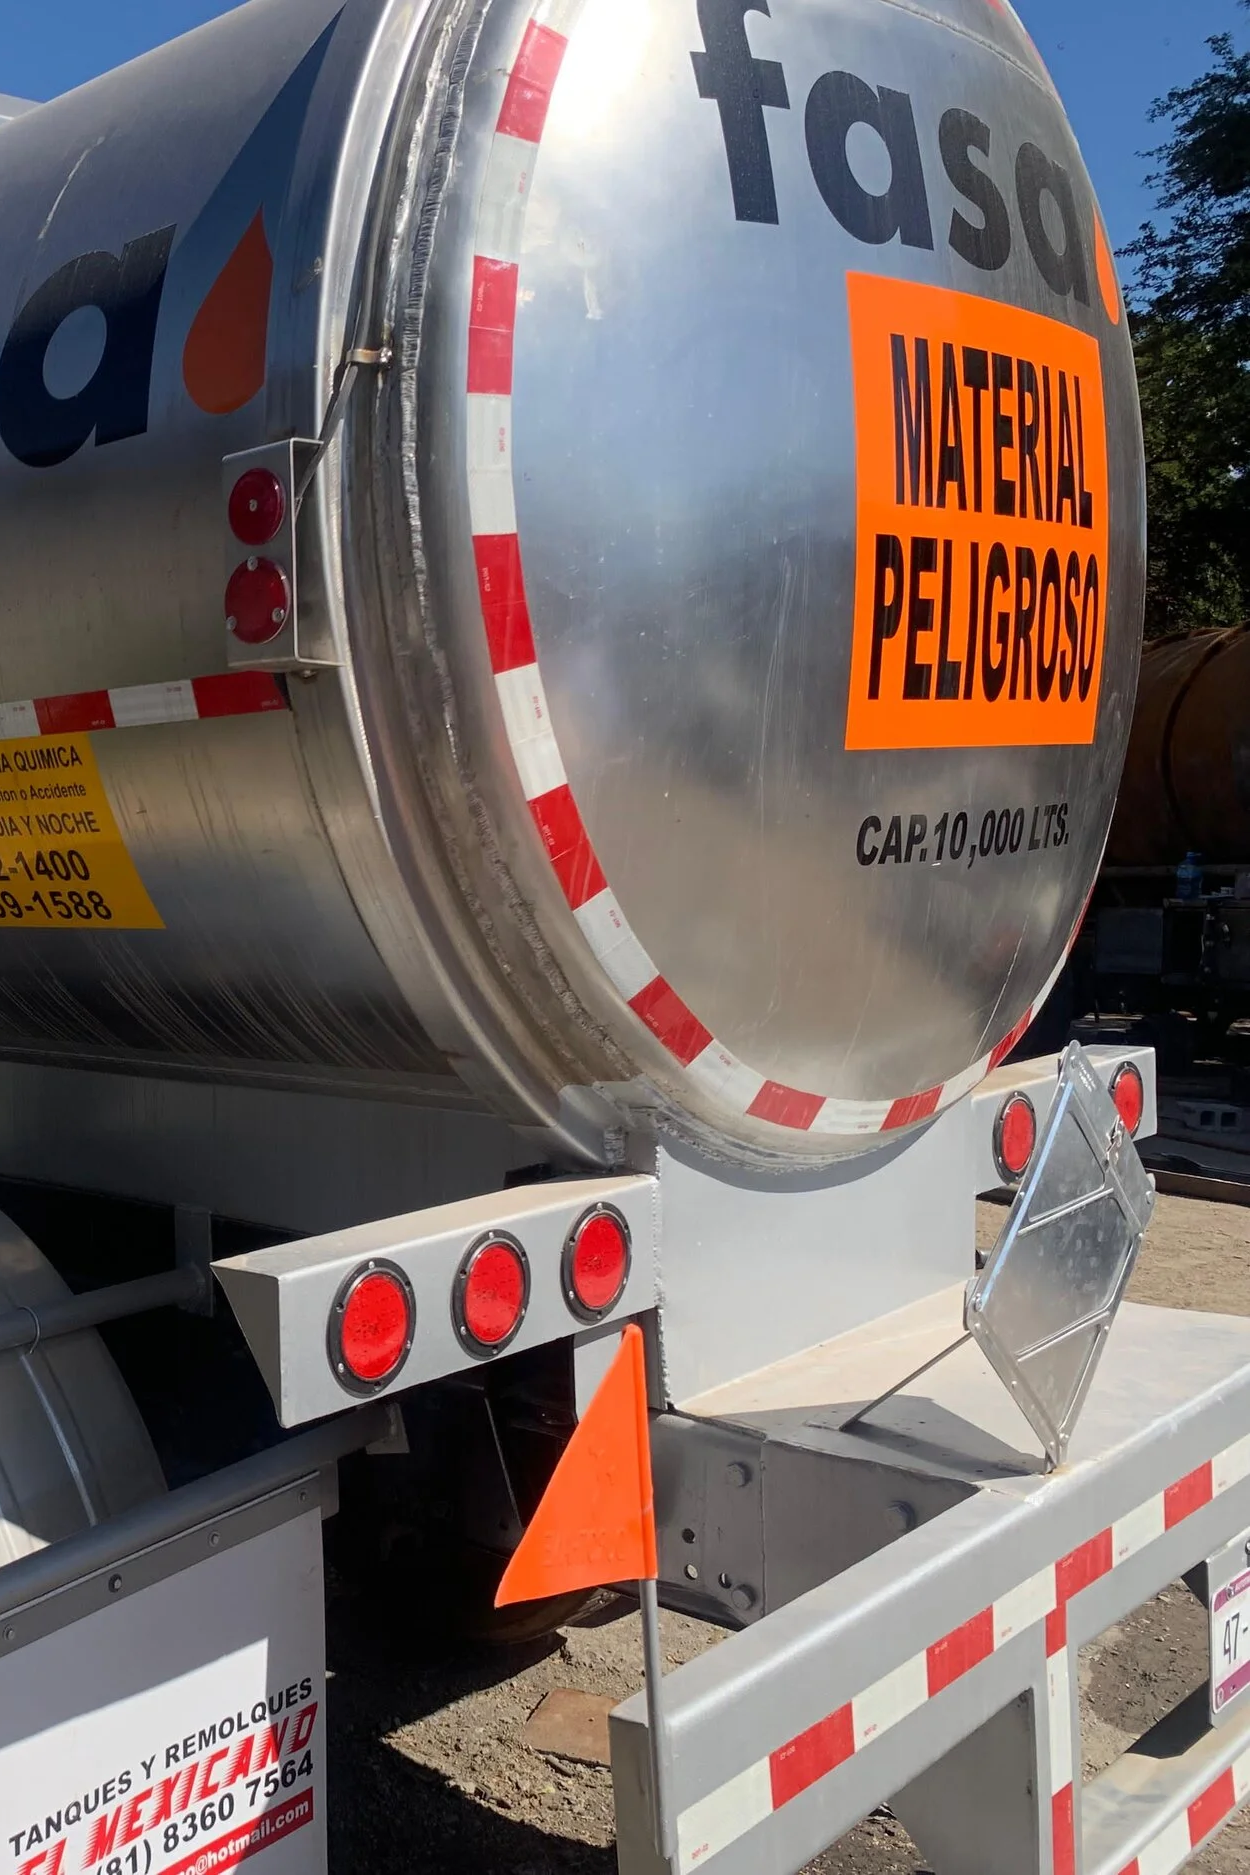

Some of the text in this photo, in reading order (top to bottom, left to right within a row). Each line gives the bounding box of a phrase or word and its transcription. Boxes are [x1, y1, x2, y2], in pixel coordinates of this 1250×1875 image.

[690, 0, 1090, 307] fasa
[890, 333, 1094, 530] MATERIAL
[867, 533, 1100, 704] PELIGROSO
[13, 745, 83, 772] QUIMICA
[19, 789, 28, 801] o
[29, 783, 87, 801] Accidente
[19, 815, 34, 836] Y
[35, 811, 101, 835] NOCHE
[1027, 803, 1069, 851] LTS.
[8, 1677, 313, 1858] TANQUES Y REMOLQUES
[80, 1701, 318, 1871] MEXICANO
[96, 1749, 313, 1875] 81) 8360 7564
[177, 1800, 310, 1875] o@hotmail.com
